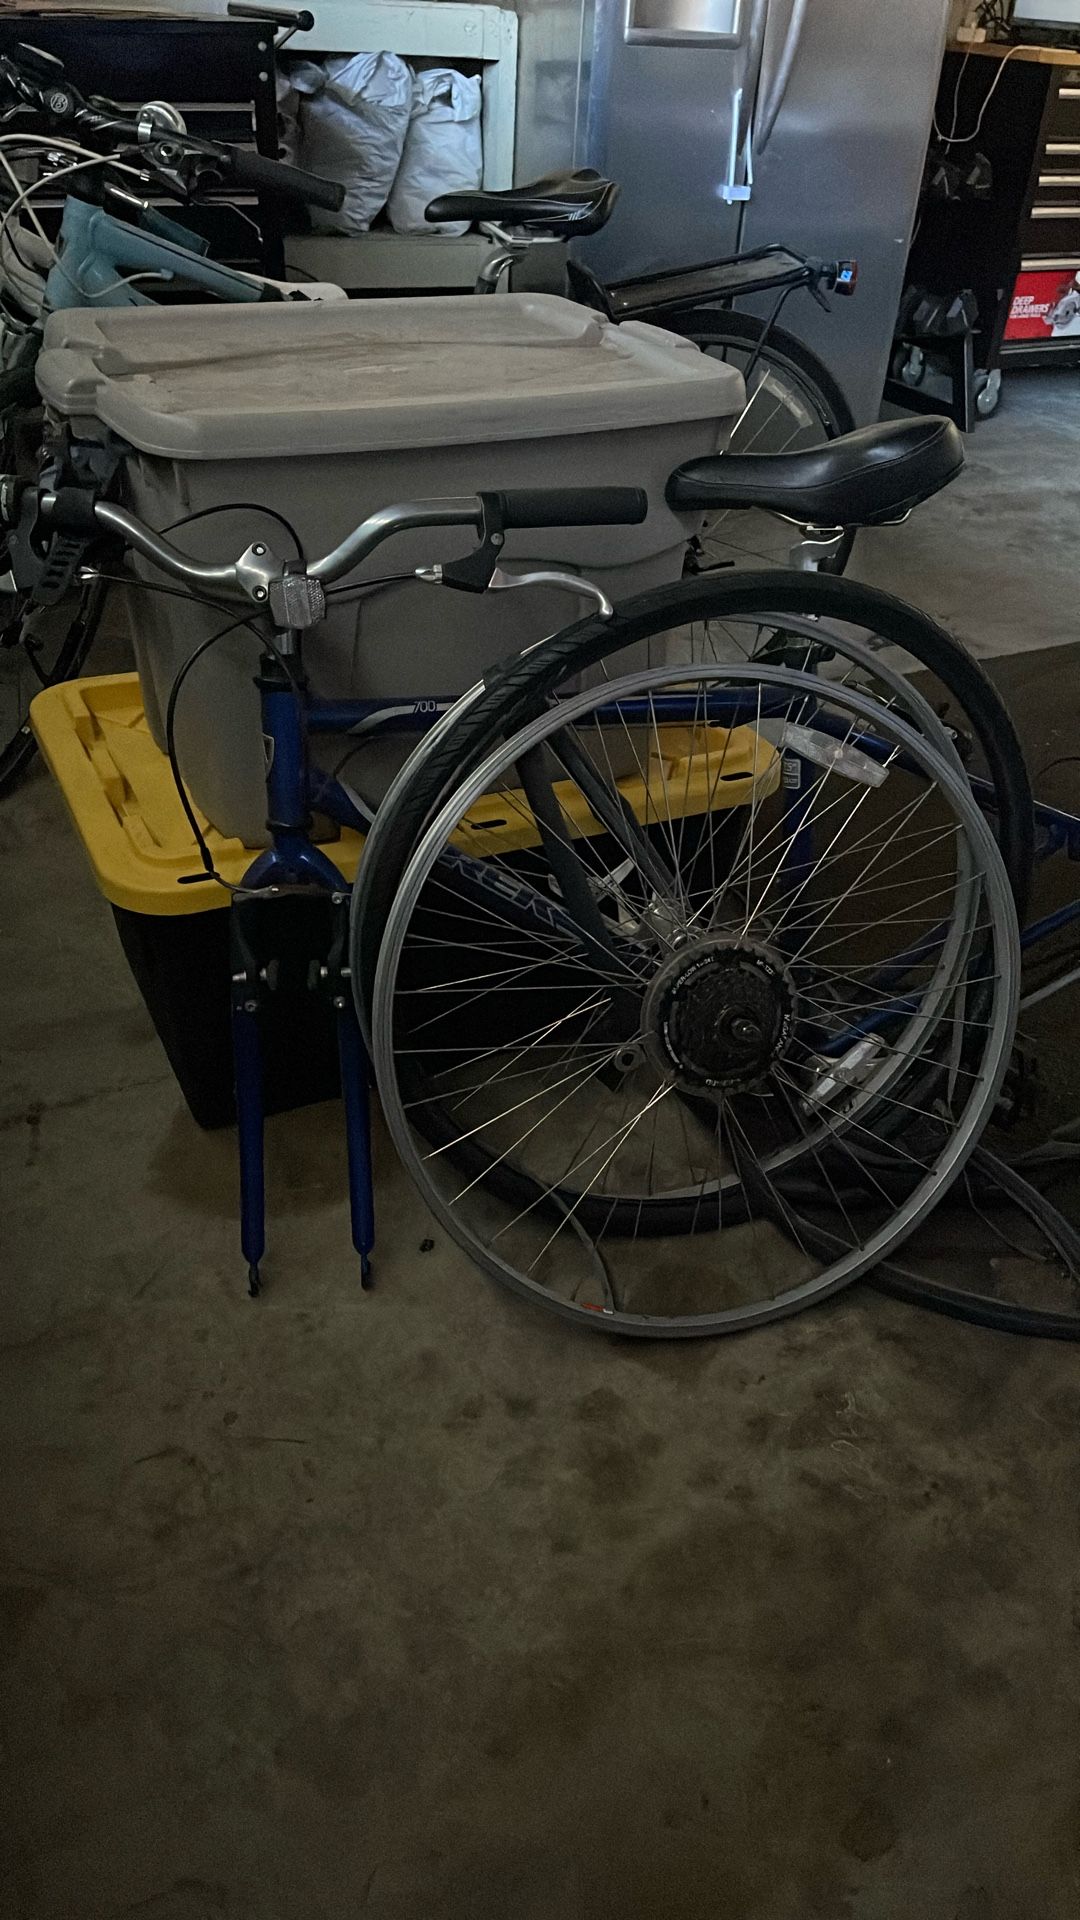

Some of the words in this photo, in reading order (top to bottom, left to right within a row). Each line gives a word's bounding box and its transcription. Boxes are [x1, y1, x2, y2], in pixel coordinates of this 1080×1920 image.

[1012, 295, 1035, 305] DEEP
[1010, 303, 1050, 315] DRAWERS
[414, 700, 436, 713] 700
